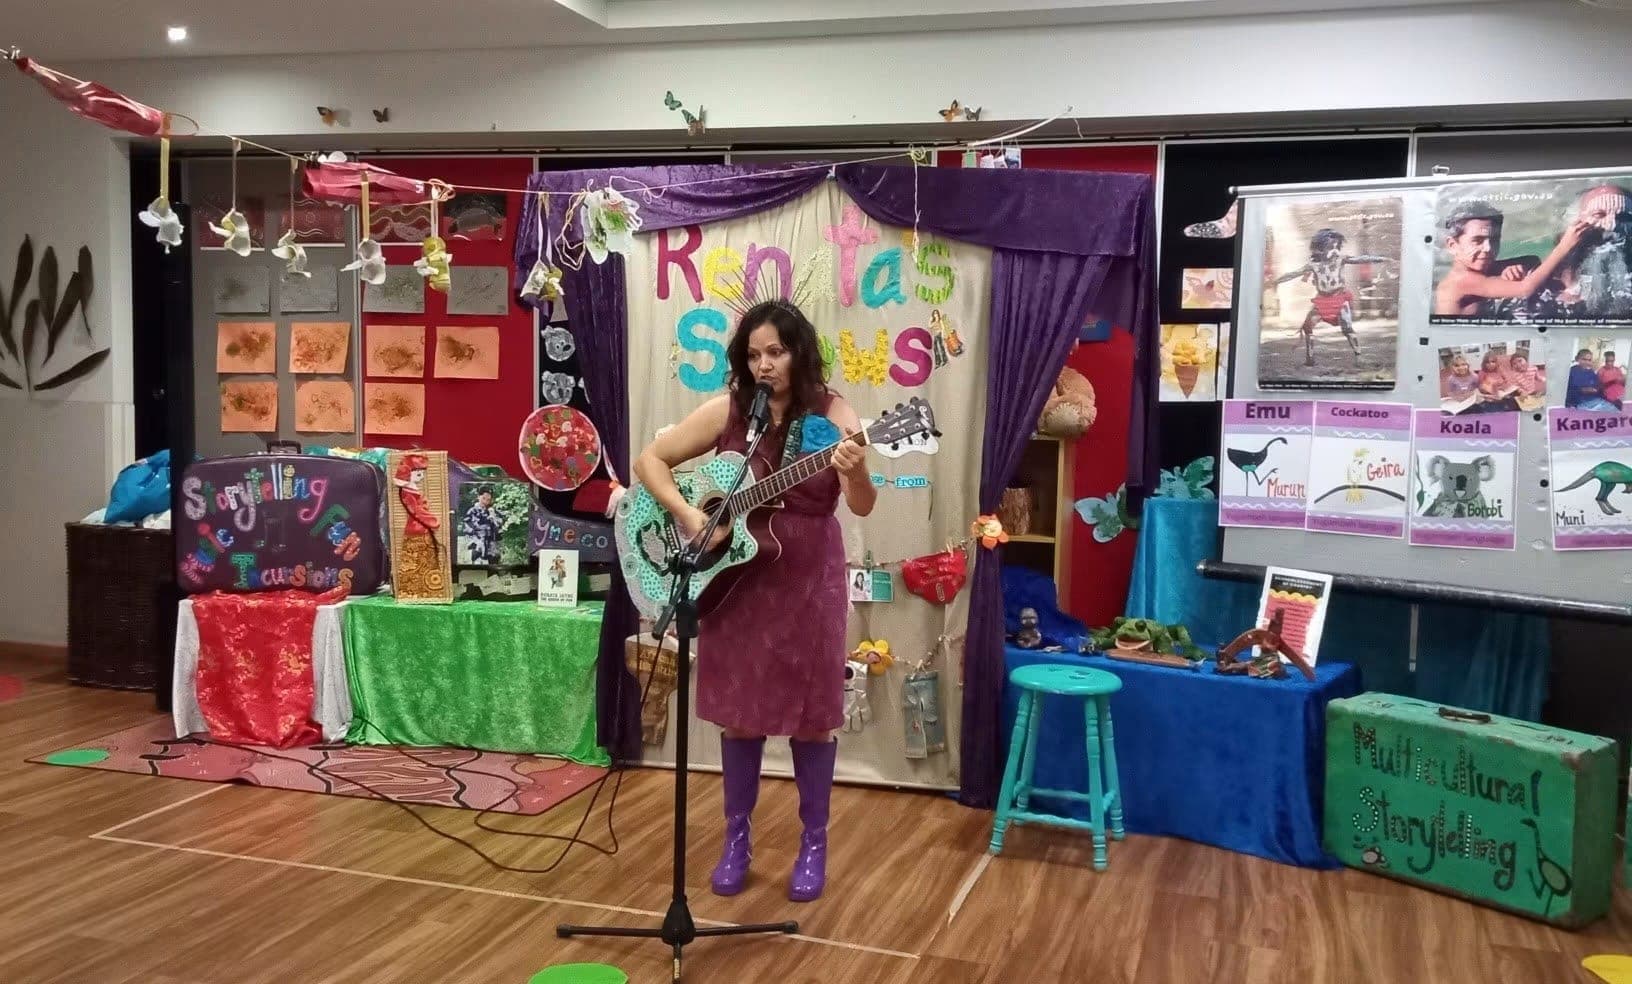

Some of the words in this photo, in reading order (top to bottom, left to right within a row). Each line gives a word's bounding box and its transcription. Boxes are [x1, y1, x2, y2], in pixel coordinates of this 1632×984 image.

[1245, 403, 1291, 419] Emu
[1331, 406, 1389, 419] Cockatoo
[1440, 420, 1492, 434] Koala
[1557, 415, 1632, 433] Kangar
[1366, 457, 1406, 481] Geira
[895, 476, 926, 488] from
[182, 463, 328, 532] Storytelling
[1555, 510, 1586, 526] Muni
[1353, 721, 1543, 817] Multicultural
[1352, 785, 1517, 891] Storytelling
